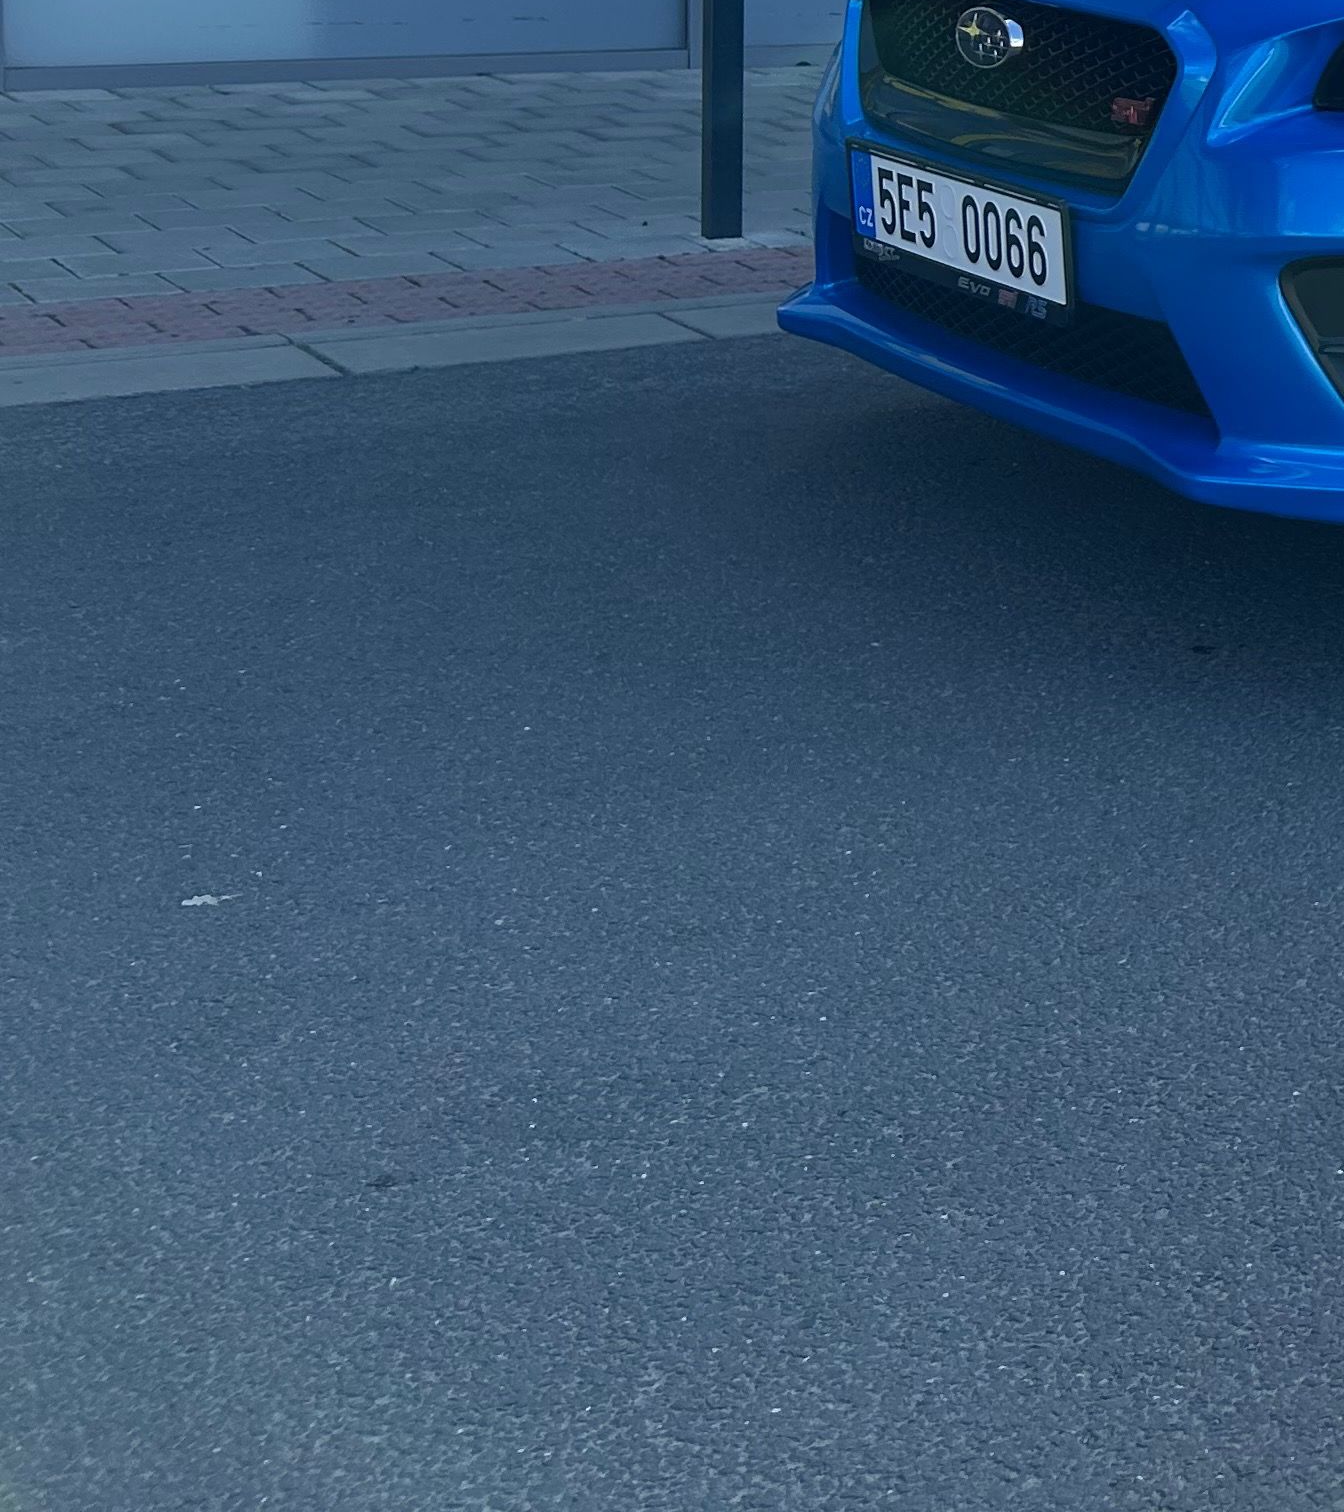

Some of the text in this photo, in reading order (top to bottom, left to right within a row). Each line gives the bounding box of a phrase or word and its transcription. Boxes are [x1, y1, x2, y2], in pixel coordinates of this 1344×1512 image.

[858, 204, 875, 228] CZ
[878, 167, 1048, 287] 5E5 0066
